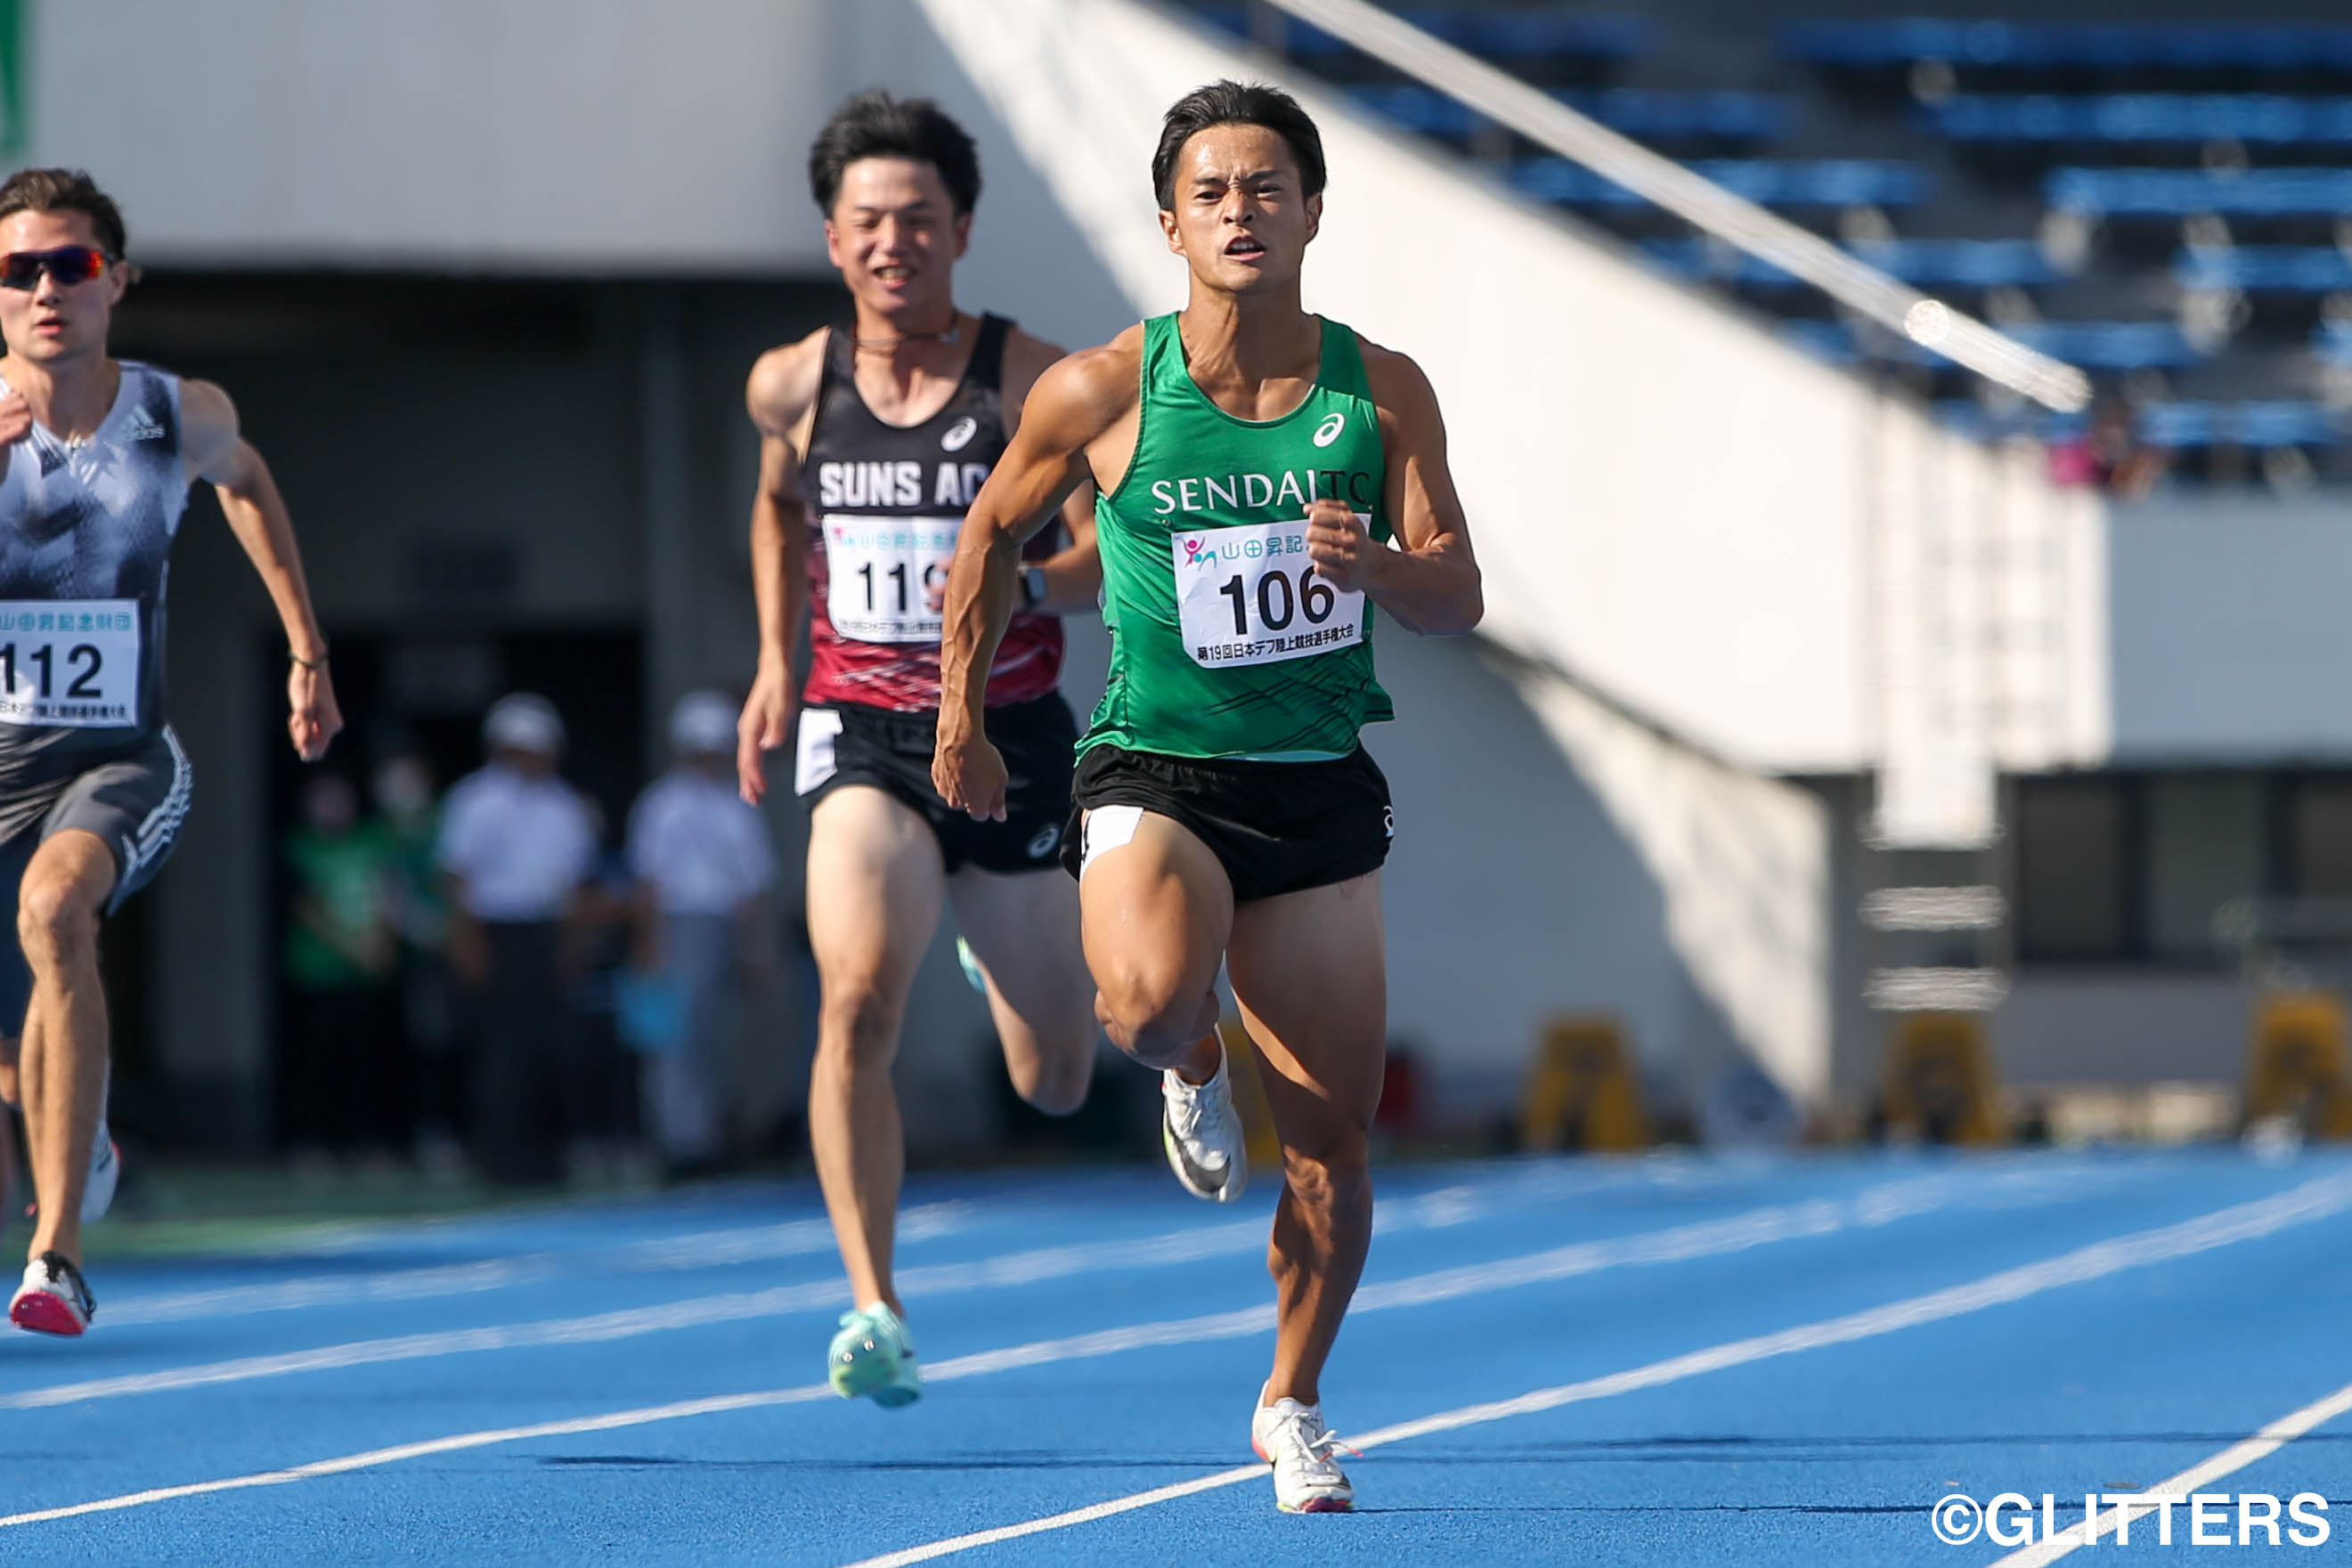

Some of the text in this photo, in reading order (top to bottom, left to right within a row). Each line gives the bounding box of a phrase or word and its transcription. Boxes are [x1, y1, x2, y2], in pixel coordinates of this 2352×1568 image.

[819, 461, 922, 508] SUNS
[1222, 535, 1310, 560] 山田昇記
[1220, 565, 1334, 636] 106
[0, 643, 102, 698] 112
